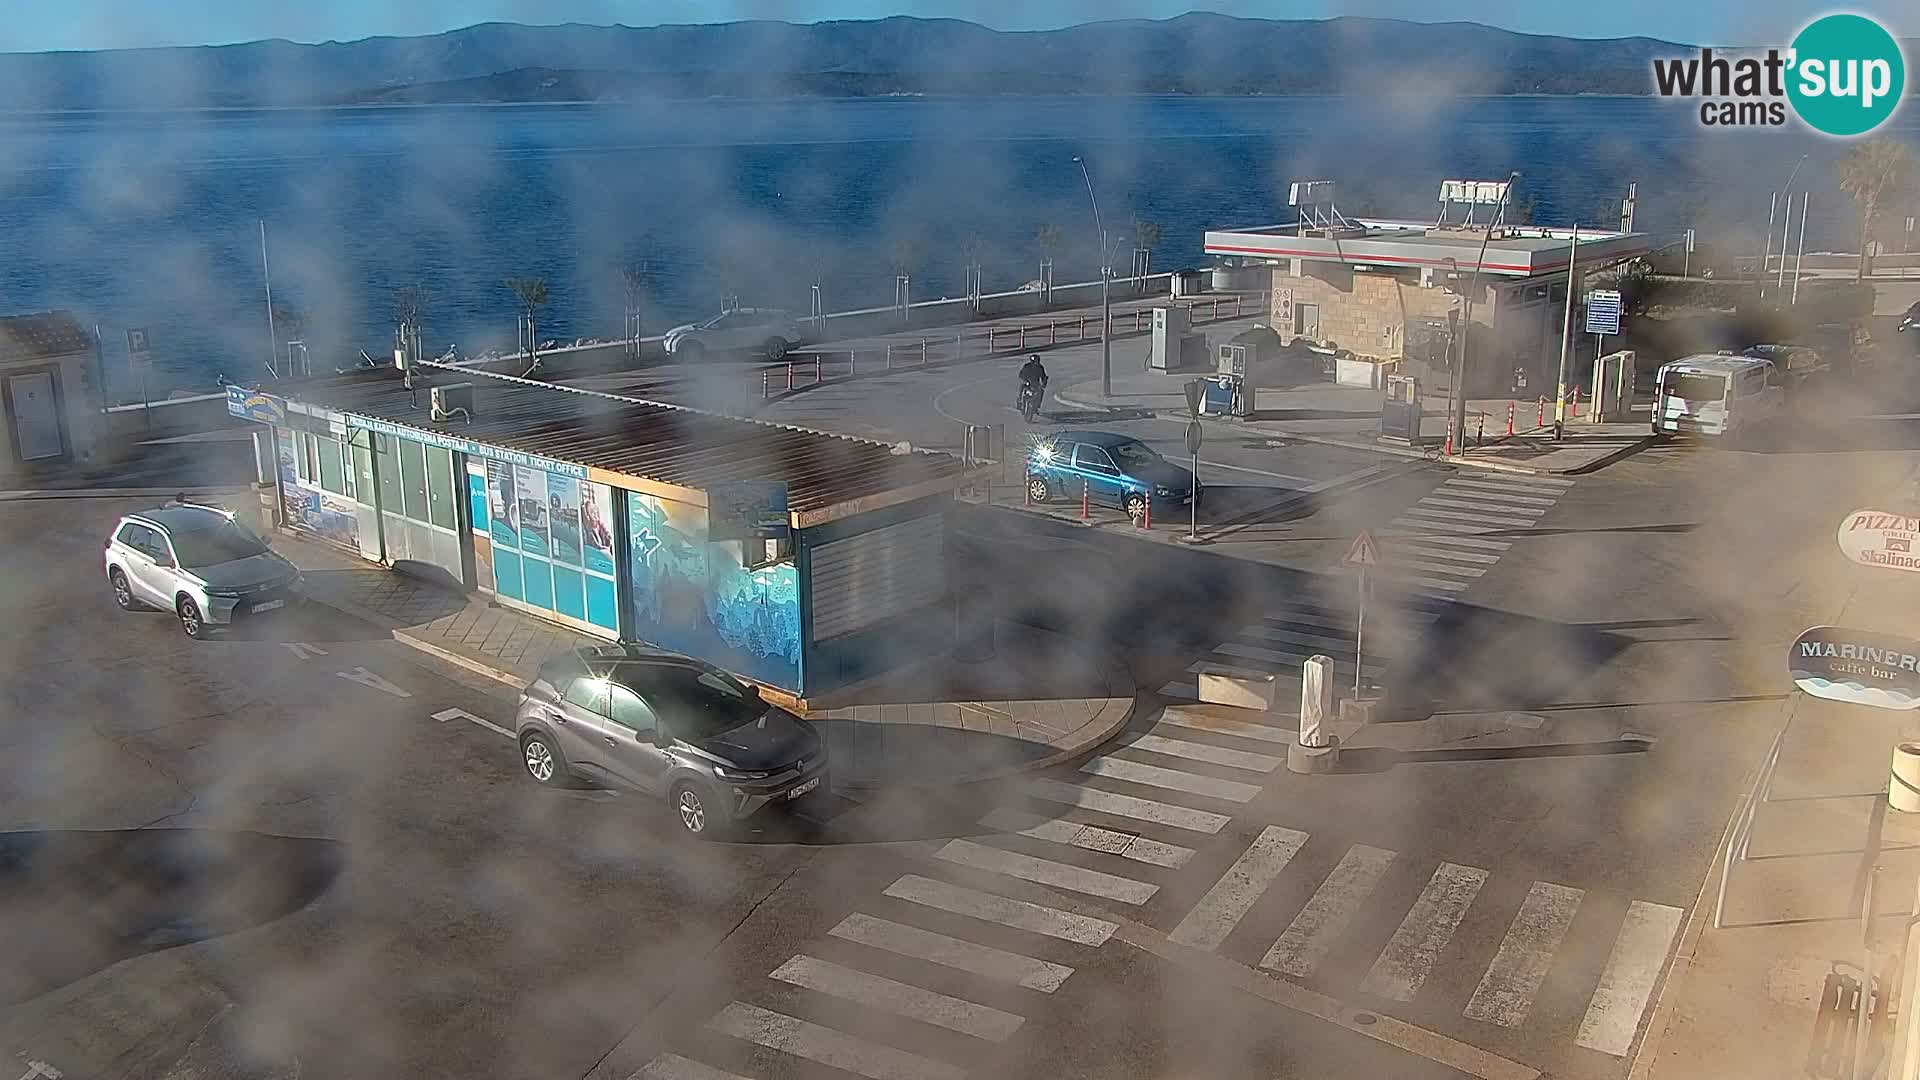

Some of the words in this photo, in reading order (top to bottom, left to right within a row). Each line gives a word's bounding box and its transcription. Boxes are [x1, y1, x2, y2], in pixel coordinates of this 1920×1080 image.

[437, 434, 469, 451] POSTAJA
[479, 444, 494, 457] BUS
[495, 449, 527, 465] STATION
[529, 455, 556, 471] TICKET
[556, 463, 583, 477] OFFICE
[1848, 515, 1920, 533] PIZZE
[1830, 662, 1866, 675] caffe
[1871, 665, 1897, 680] bar
